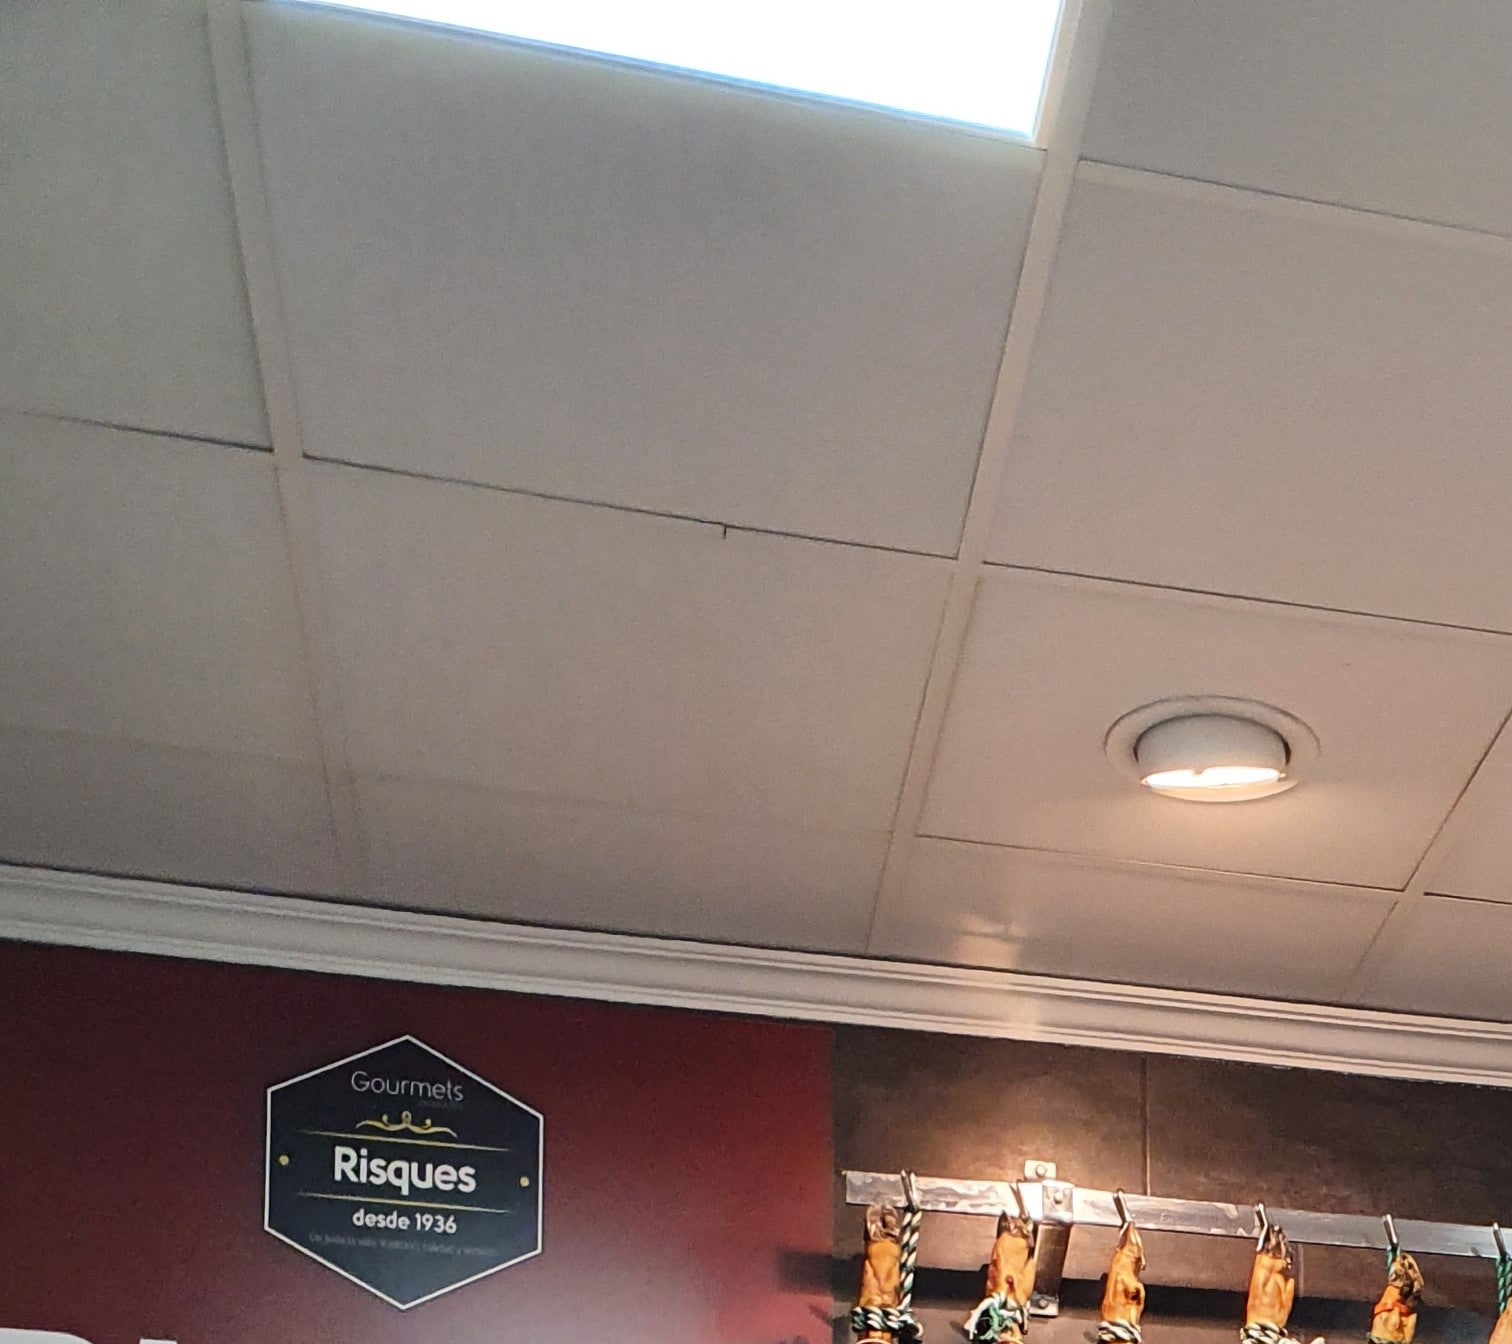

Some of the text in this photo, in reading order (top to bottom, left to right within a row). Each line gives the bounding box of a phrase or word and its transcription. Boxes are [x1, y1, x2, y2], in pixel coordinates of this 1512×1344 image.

[351, 1070, 464, 1102] Gourmets
[333, 1145, 477, 1196] Risques
[352, 1208, 457, 1234] desde 1936
